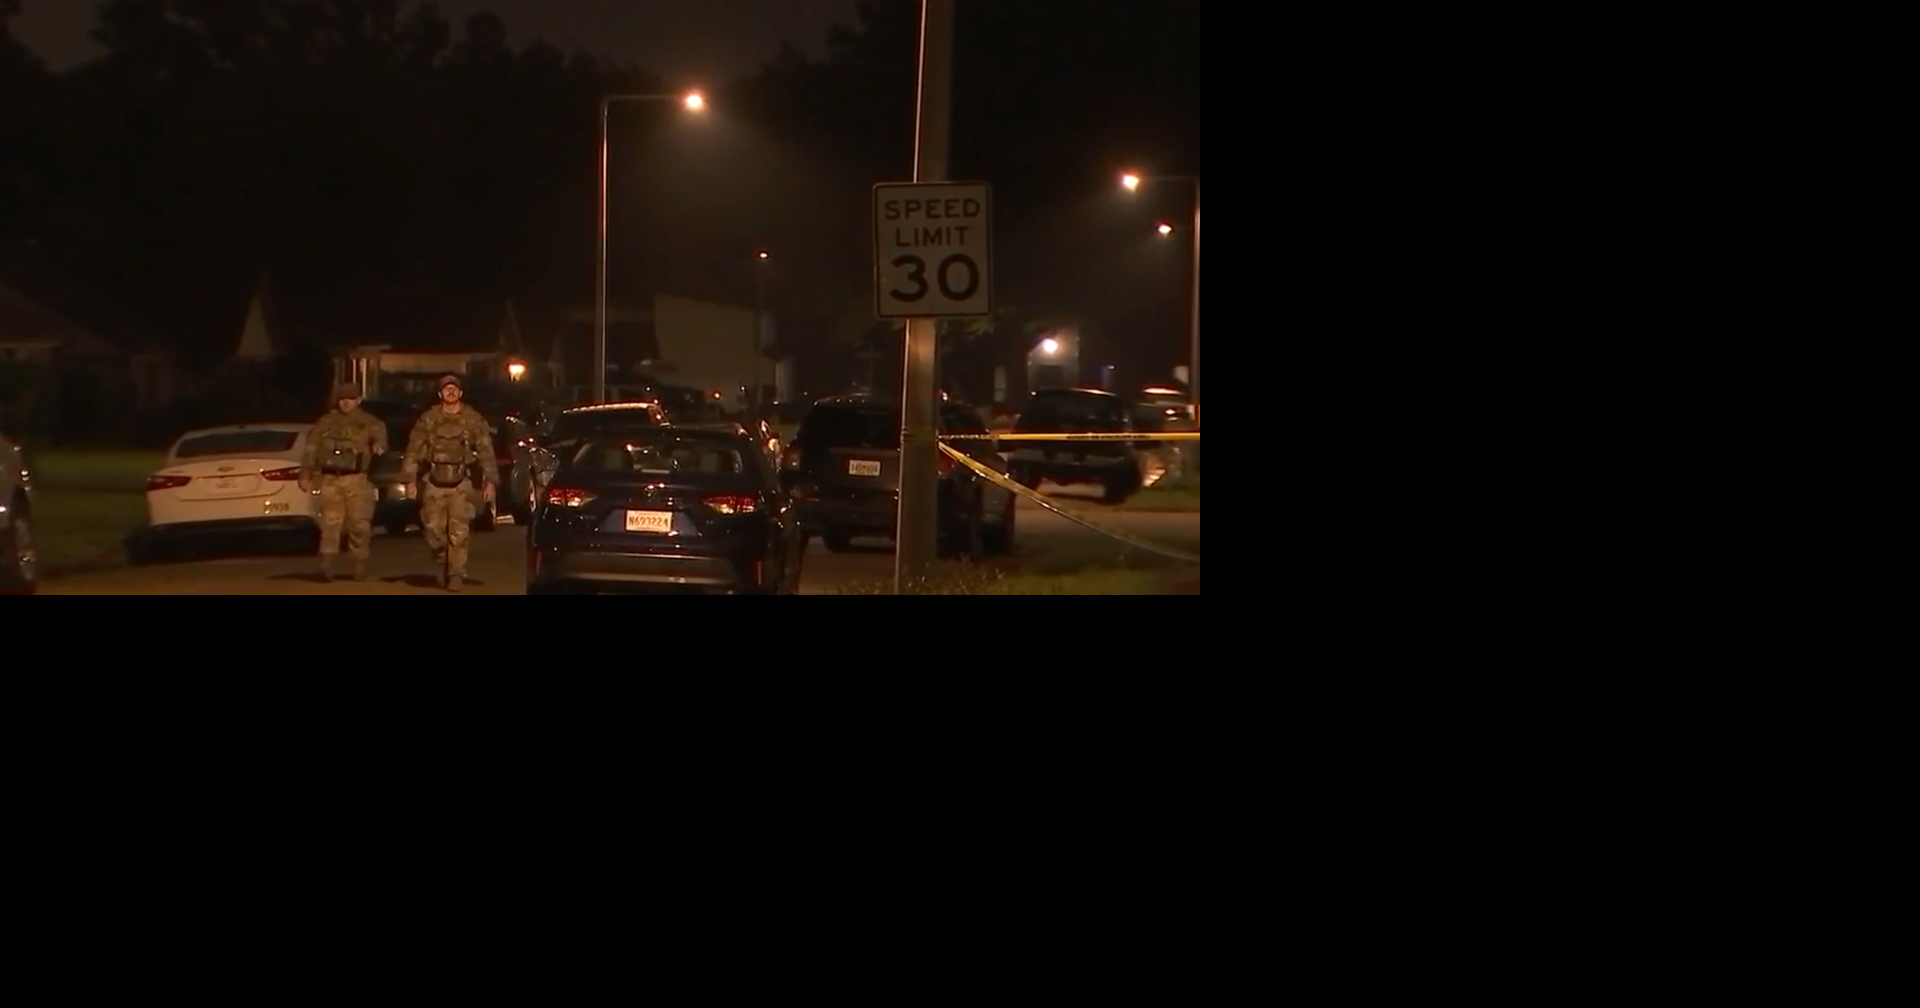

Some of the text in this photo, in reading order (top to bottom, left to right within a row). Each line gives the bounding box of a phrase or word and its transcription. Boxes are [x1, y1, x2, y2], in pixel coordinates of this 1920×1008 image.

[885, 198, 980, 219] SPEED
[896, 226, 968, 246] LIMIT
[890, 253, 979, 302] 30
